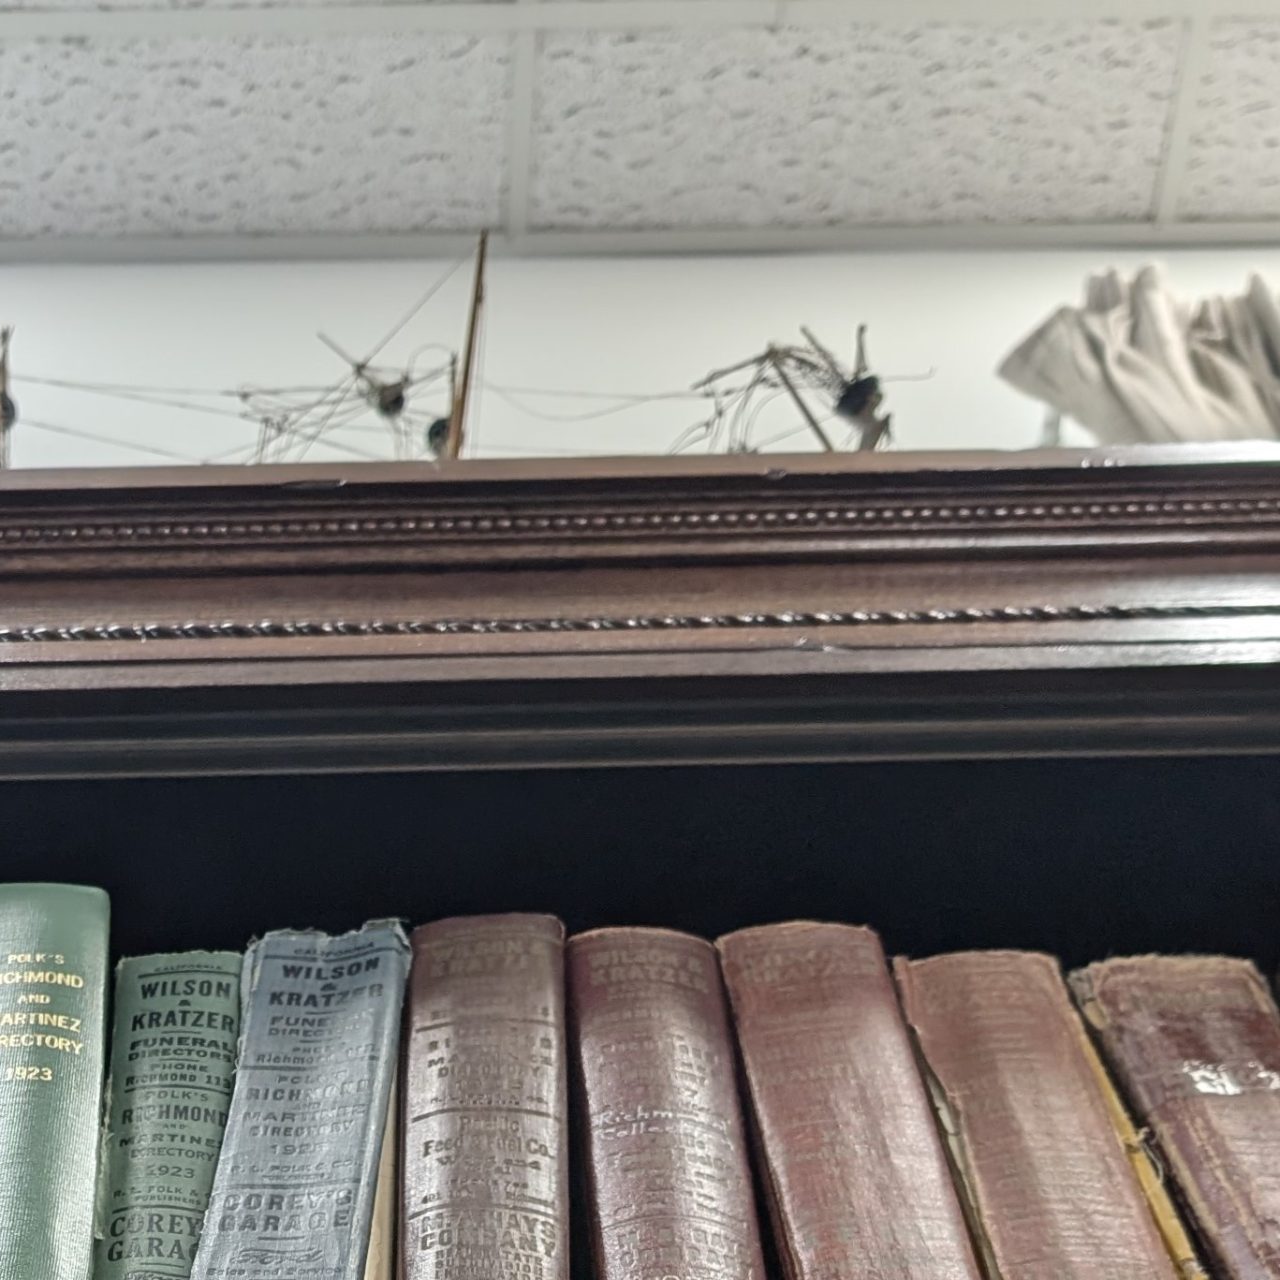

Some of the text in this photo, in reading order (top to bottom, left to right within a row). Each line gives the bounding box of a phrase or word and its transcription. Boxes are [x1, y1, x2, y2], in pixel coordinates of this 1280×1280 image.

[282, 956, 380, 980] WILSON
[140, 979, 231, 1000] WILSON
[269, 983, 383, 1007] KRATZER
[17, 993, 50, 1005] AND
[131, 1009, 235, 1034] KRATZER
[130, 1036, 233, 1054] FUNERAL
[128, 1049, 232, 1063] DIRECTORS
[5, 1067, 53, 1081] 1923
[125, 1073, 197, 1087] RICHMOND
[145, 1089, 209, 1102] POLK'S
[122, 1105, 228, 1129] RICHMOND
[131, 1147, 215, 1162] DIRECTORY
